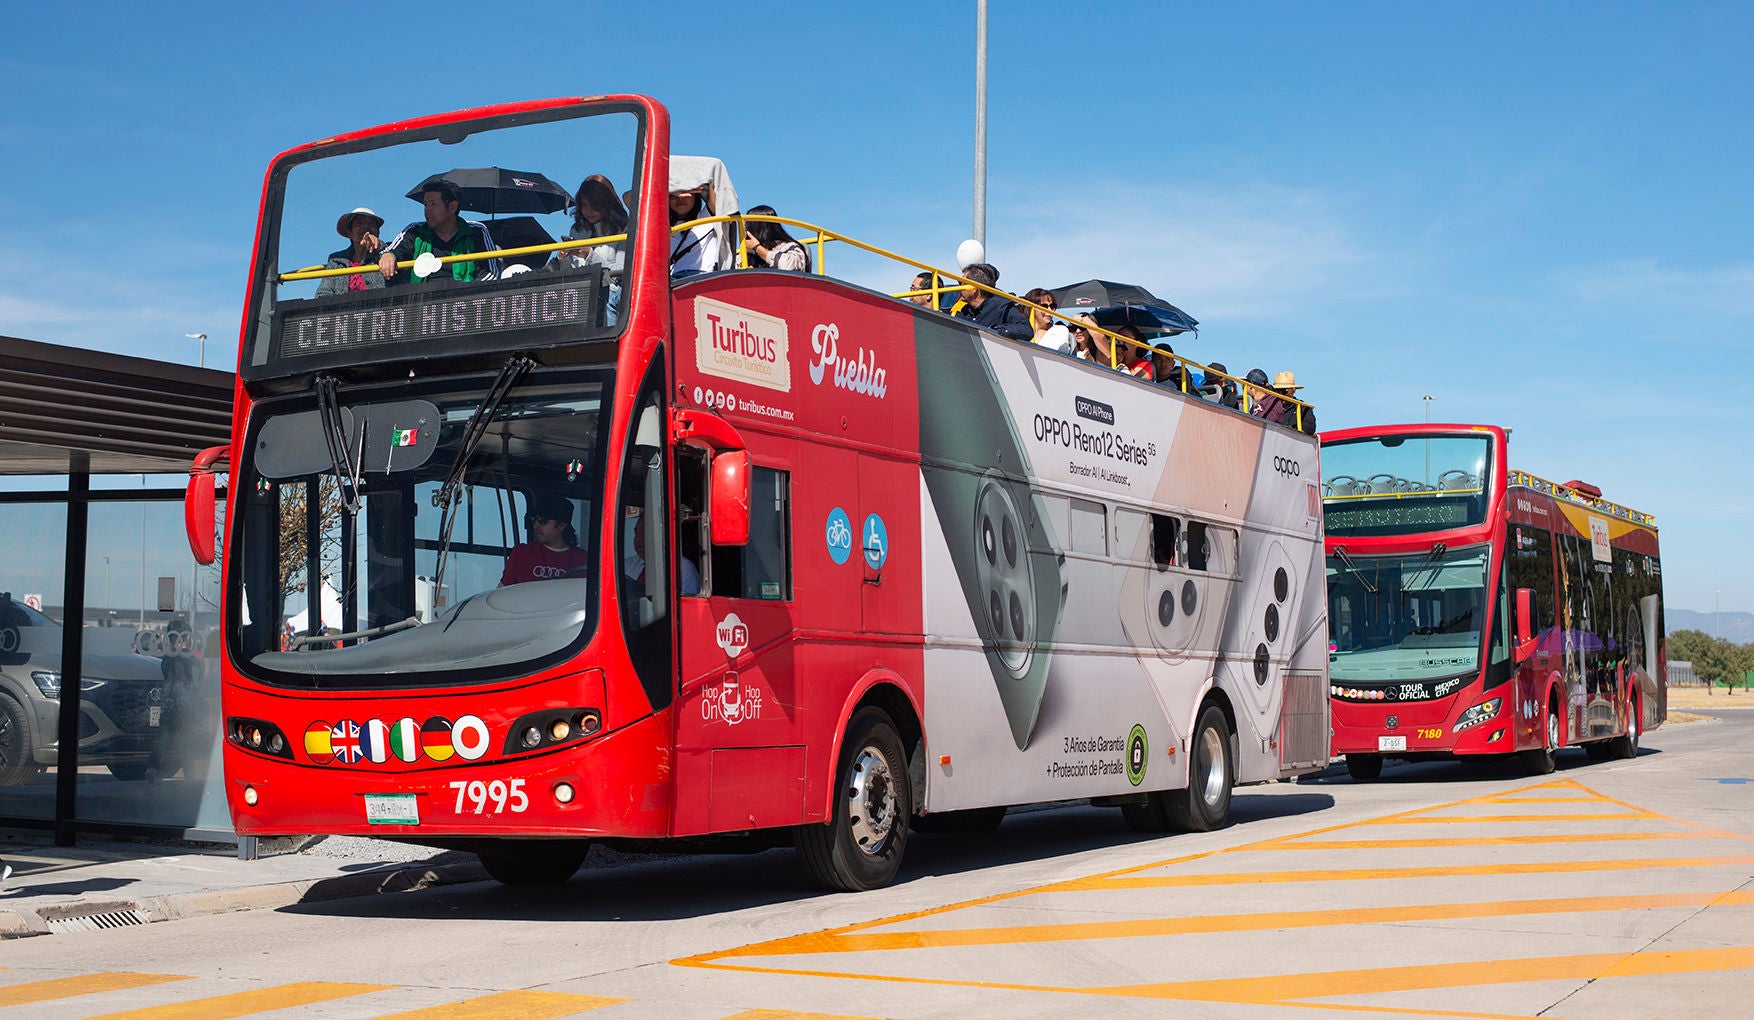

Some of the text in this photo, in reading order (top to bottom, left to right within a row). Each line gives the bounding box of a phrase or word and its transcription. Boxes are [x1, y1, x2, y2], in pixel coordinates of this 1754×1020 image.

[297, 288, 580, 348] CENTRO HISTORICO
[707, 313, 776, 363] Turibus
[714, 350, 742, 369] Circuito
[809, 323, 887, 400] Puebla
[738, 398, 795, 421] turibus.com.mx
[1076, 401, 1113, 421] OPPO AI Phone
[1034, 413, 1156, 466] OPPO Reno12 Series 5G
[1069, 461, 1091, 477] Borrador
[1273, 455, 1300, 479] oppo
[702, 684, 718, 701] Hop
[1398, 690, 1431, 700] OFICIAL
[1399, 683, 1423, 692] TOUR
[1435, 686, 1450, 697] CITY
[701, 699, 718, 720] On
[744, 699, 762, 720] Off
[1417, 728, 1443, 739] 7180
[1064, 736, 1124, 753] 3 Años de Garantía
[1052, 761, 1088, 778] Protección
[1088, 760, 1098, 775] de
[1098, 759, 1124, 775] Pantalla
[449, 778, 529, 815] 7995
